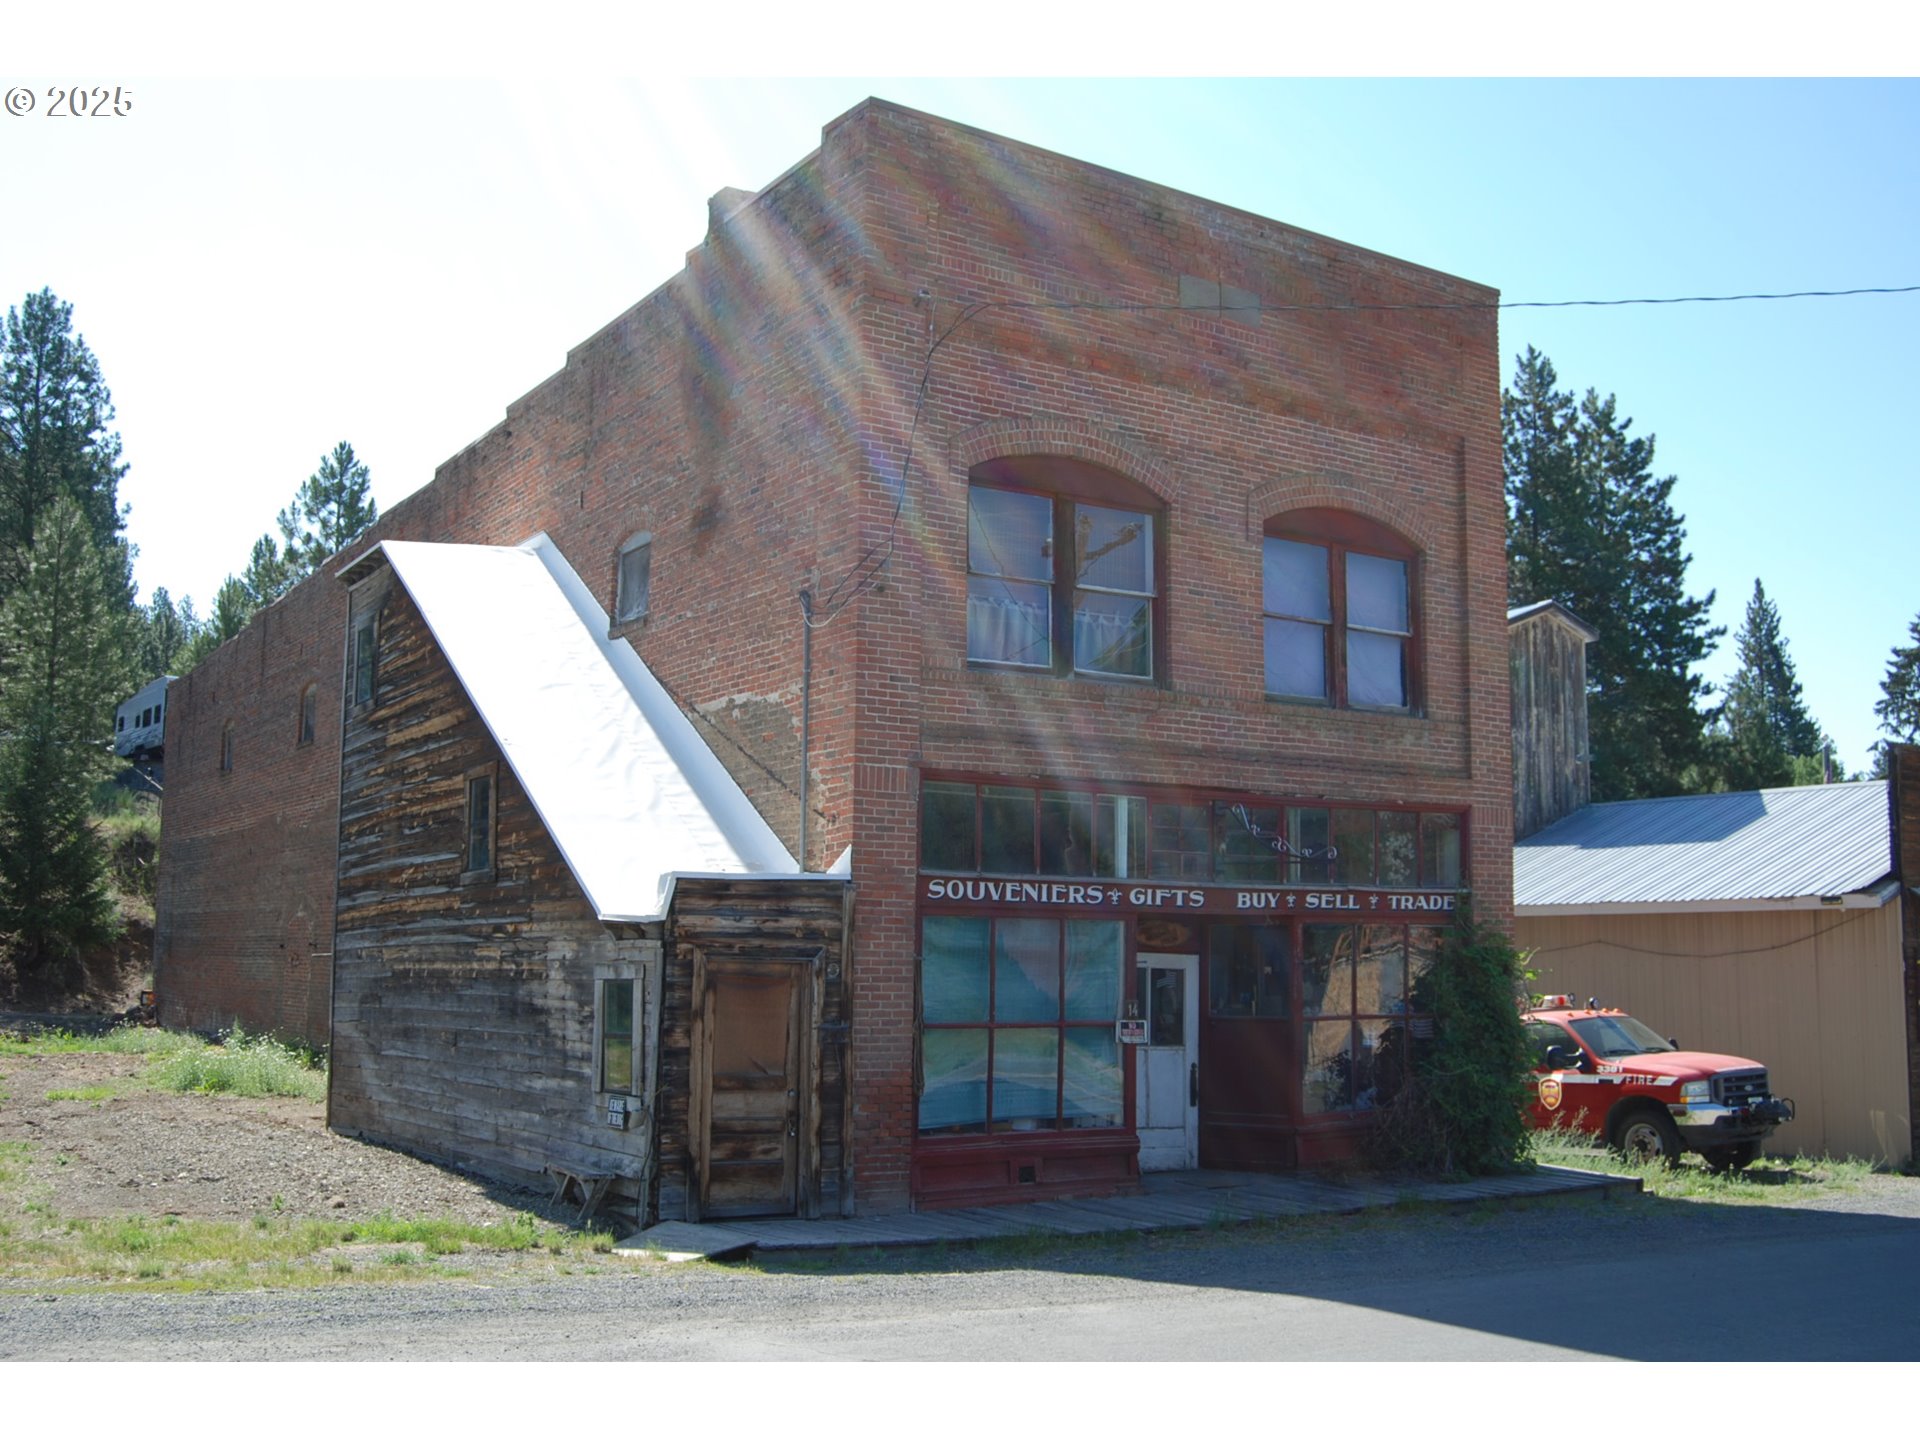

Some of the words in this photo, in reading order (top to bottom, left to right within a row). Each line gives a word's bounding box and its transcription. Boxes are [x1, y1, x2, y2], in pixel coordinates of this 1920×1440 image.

[927, 879, 1104, 905] SOUVENIERS
[1128, 887, 1205, 908] GIFTS
[1236, 892, 1281, 909] BUY
[1304, 892, 1360, 909] SELL
[1387, 894, 1456, 911] TRADE
[1625, 1074, 1654, 1085] FIRE
